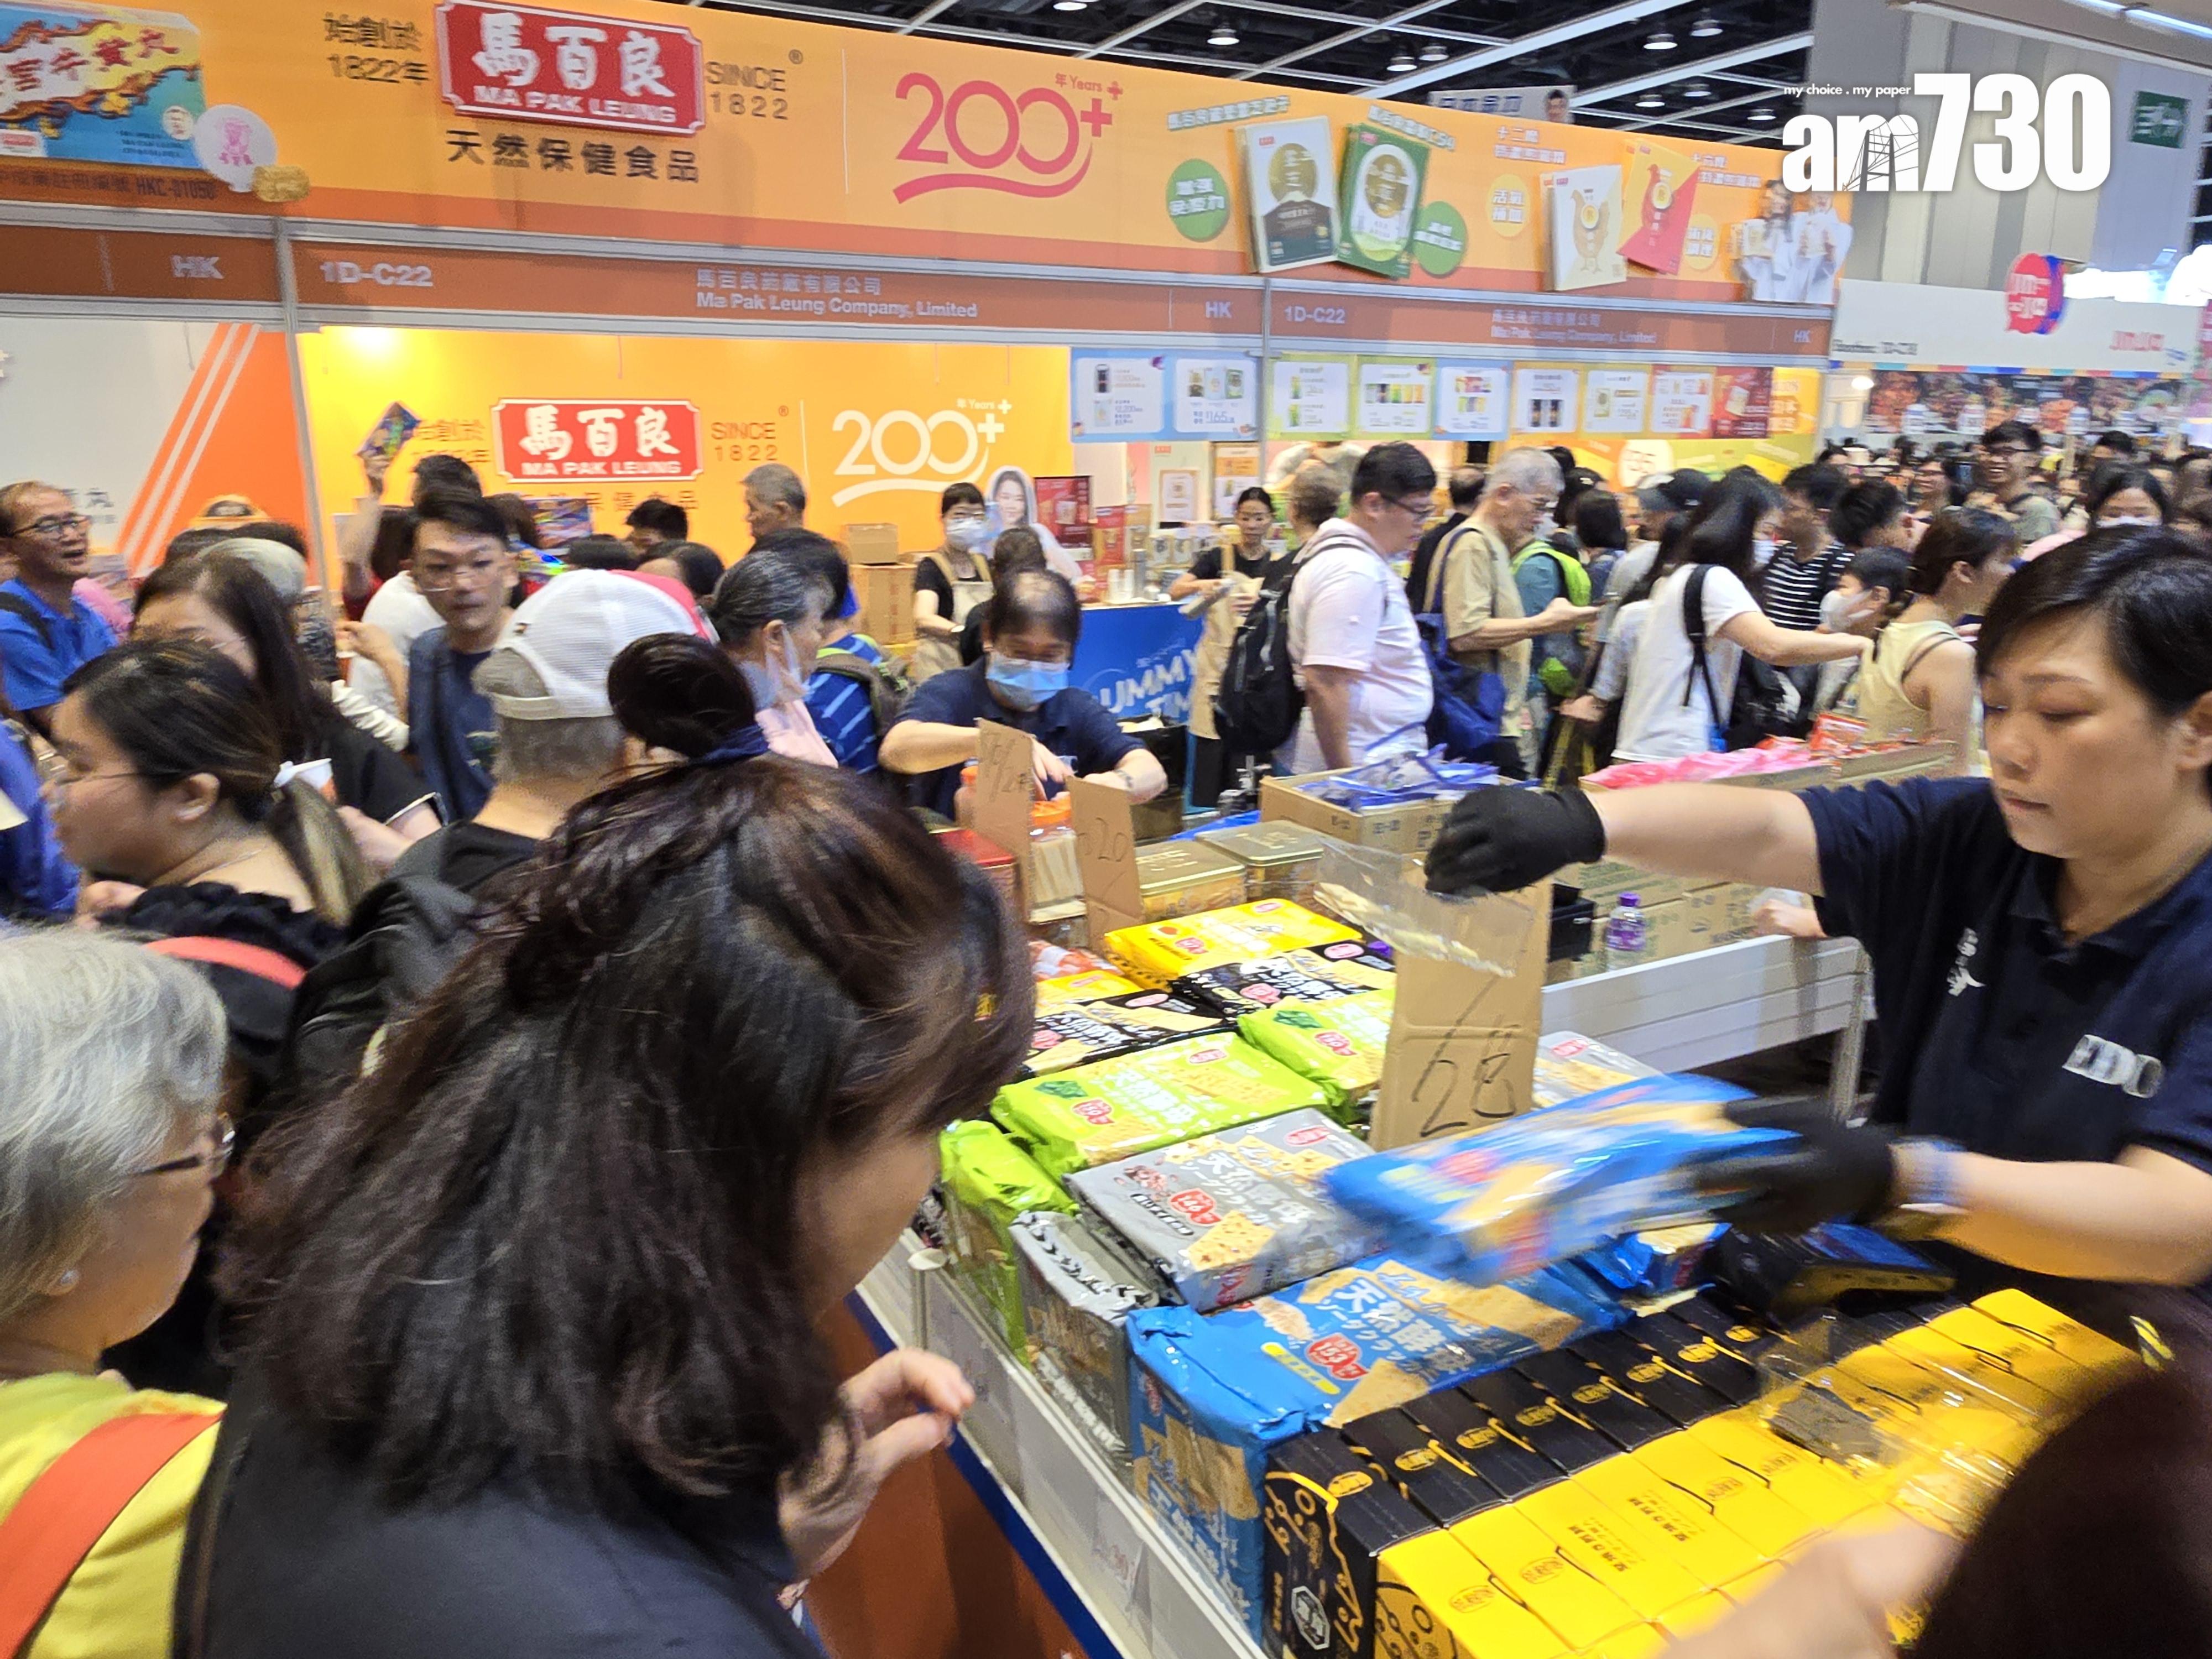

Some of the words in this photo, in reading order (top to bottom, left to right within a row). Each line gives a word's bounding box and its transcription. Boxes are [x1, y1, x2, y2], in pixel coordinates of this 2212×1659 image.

[472, 12, 676, 98] 馬百良
[706, 61, 786, 91] SINCE
[1070, 75, 1103, 92] Years
[473, 86, 521, 106] MA
[525, 91, 583, 113] PAK
[710, 92, 787, 120] 1822
[446, 130, 699, 184] 天然保健食品
[171, 255, 224, 279] HK
[320, 262, 433, 287] 1D-C22
[696, 291, 728, 308] Ma
[731, 293, 766, 310] Pak
[769, 295, 826, 315] Leung
[828, 296, 913, 319] Company,
[916, 300, 978, 318] Limited
[1205, 301, 1232, 319] HK
[1284, 305, 1345, 324] 1D-C22
[1793, 330, 1811, 343] HK
[519, 404, 681, 461] 馬百良
[711, 422, 775, 440] SINCE
[714, 444, 779, 461] 1822
[521, 462, 559, 476] MA
[562, 462, 607, 476] PAK
[612, 461, 681, 475] LEUNG
